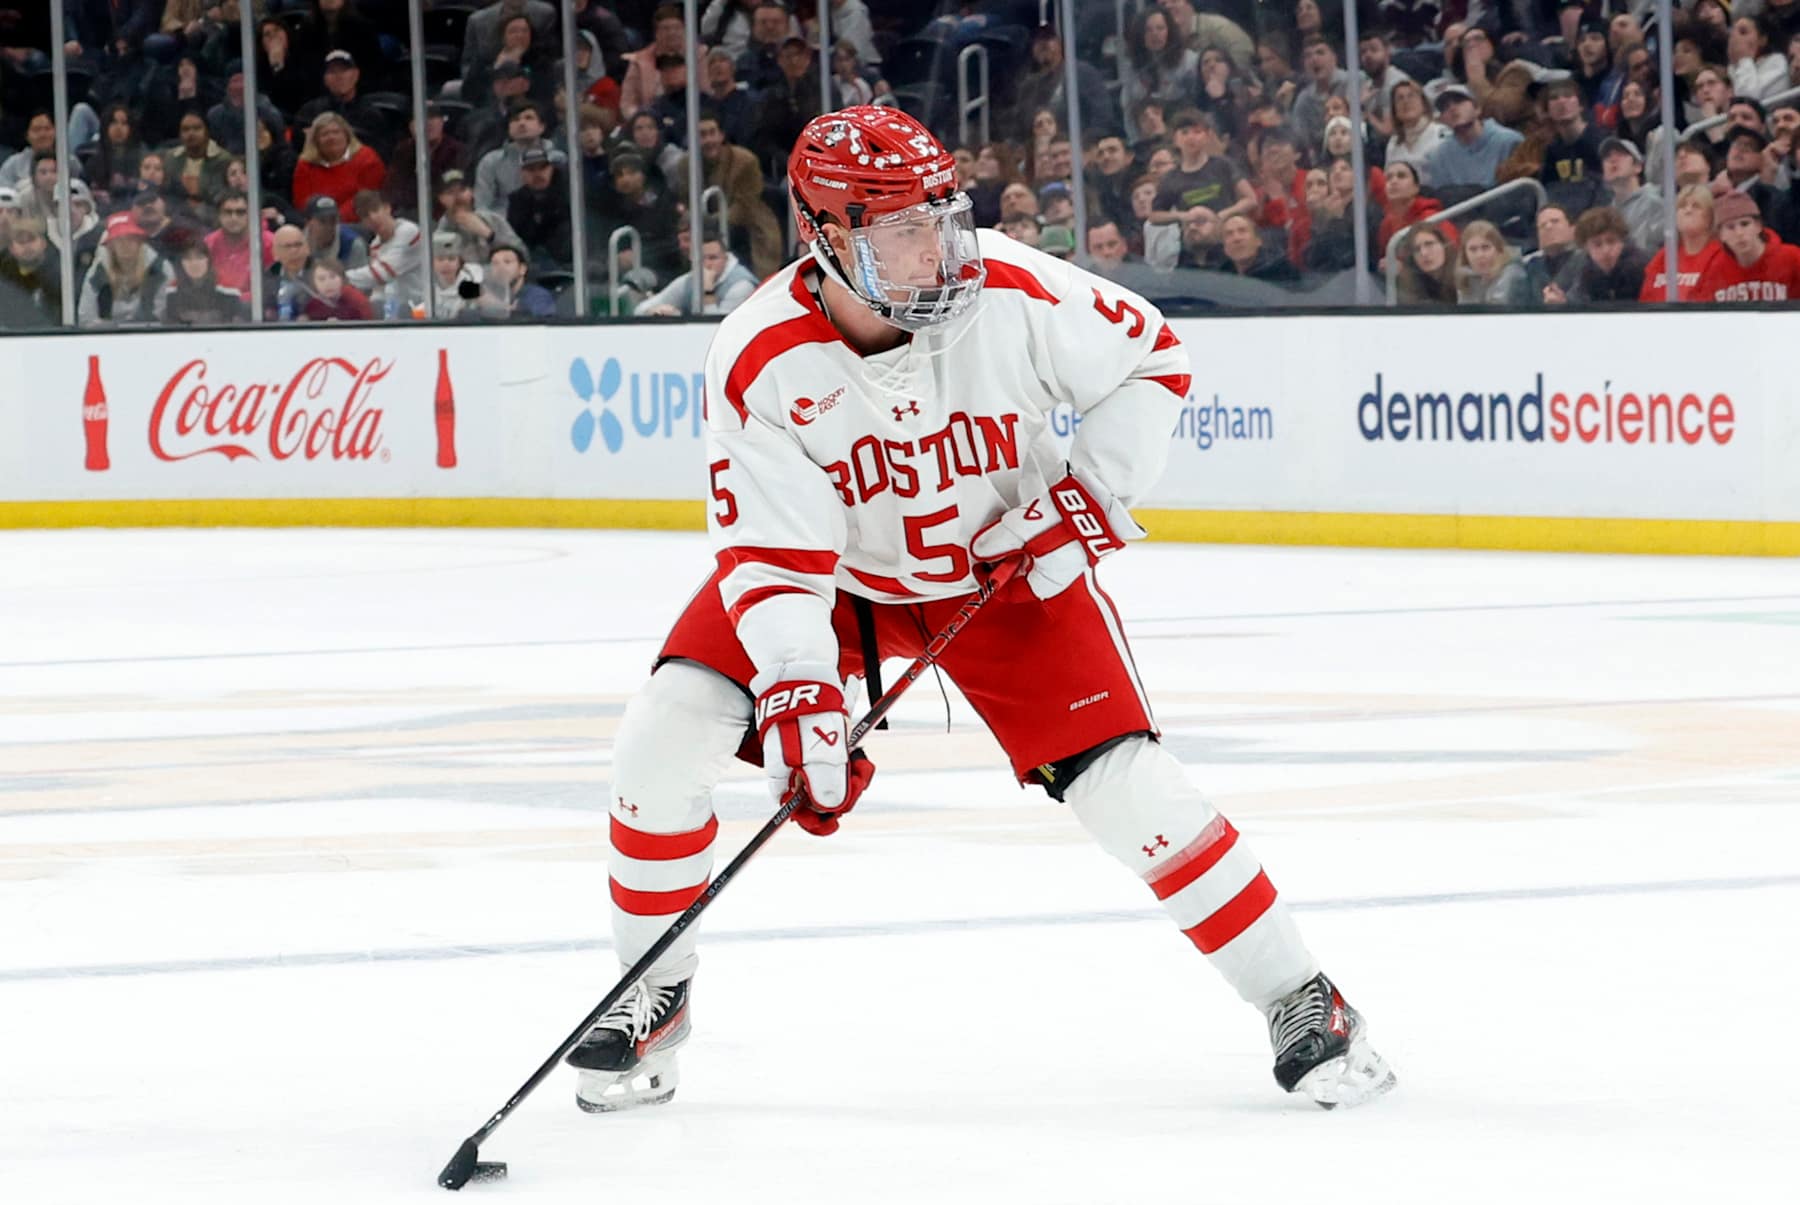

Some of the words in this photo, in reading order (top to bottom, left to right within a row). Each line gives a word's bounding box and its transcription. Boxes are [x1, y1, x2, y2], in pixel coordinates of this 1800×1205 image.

[922, 169, 954, 190] BOSTON
[1091, 287, 1146, 338] 5
[148, 357, 395, 462] Coca-Cola
[1172, 395, 1273, 450] righam
[710, 459, 738, 528] 5
[823, 411, 1019, 507] BOSTON
[903, 504, 970, 583] 5
